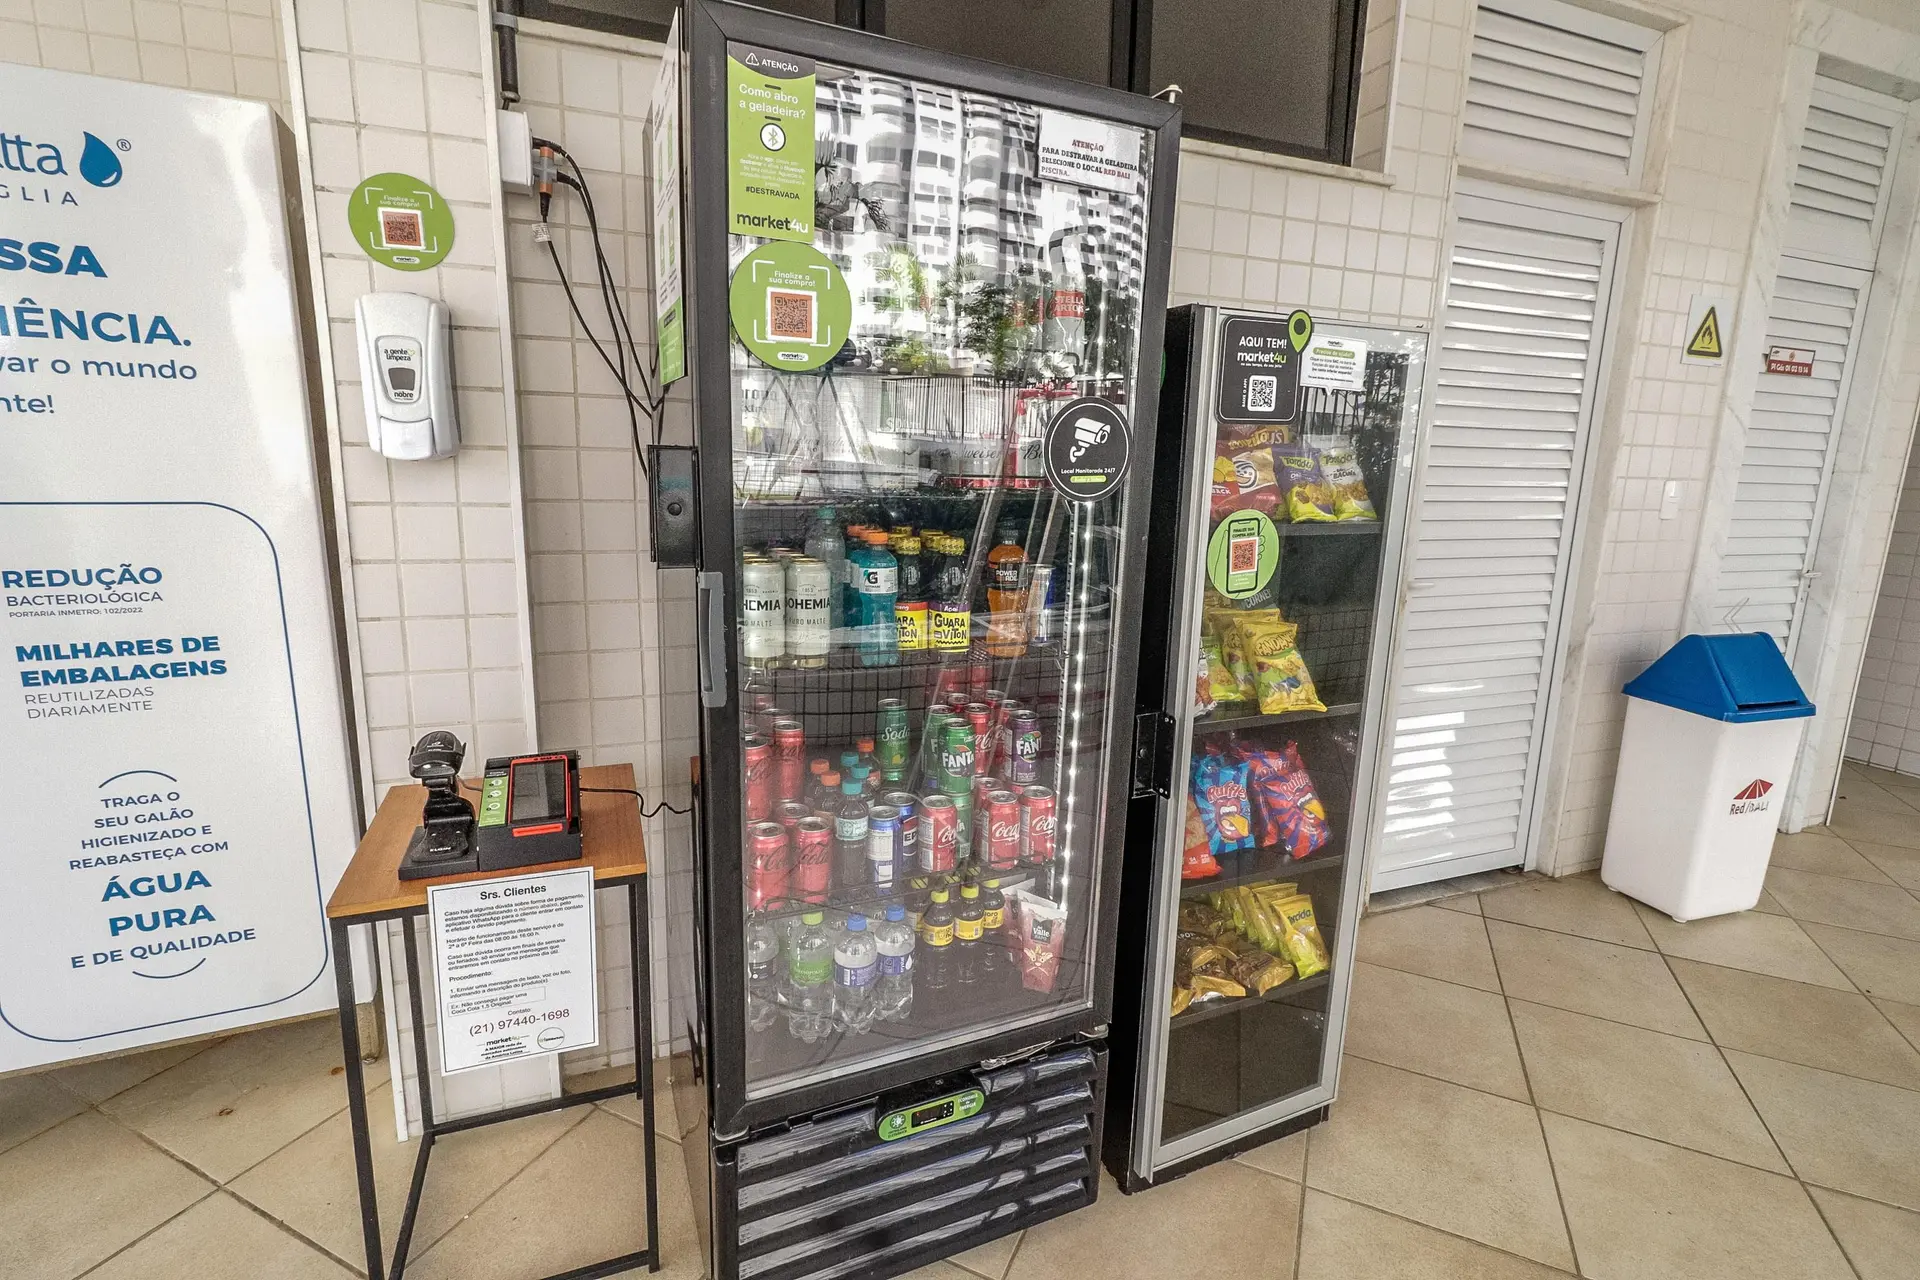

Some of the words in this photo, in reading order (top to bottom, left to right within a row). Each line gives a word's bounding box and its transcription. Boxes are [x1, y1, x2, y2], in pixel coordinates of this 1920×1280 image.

[761, 59, 799, 73] ATENÇÃO
[739, 84, 772, 99] Como
[774, 92, 799, 105] abro
[739, 100, 746, 108] a
[749, 100, 806, 120] geladeira?
[0, 132, 68, 176] tta
[1072, 139, 1104, 152] ATENÇÃO
[1042, 147, 1059, 156] PARA
[1061, 150, 1098, 163] DESTRAVAR
[1105, 159, 1138, 172] GELADEIRA
[1042, 157, 1075, 168] SELECIONE
[1082, 164, 1103, 174] LOCAL
[1103, 168, 1116, 177] RED
[746, 186, 800, 200] #DESTRAVADA
[736, 212, 809, 234] market4u
[774, 271, 803, 280] Finalize
[784, 278, 816, 287] compra!
[1239, 336, 1263, 348] AQUI
[1266, 337, 1288, 350] TEM!
[1237, 351, 1287, 363] market4u
[51, 358, 71, 375] o
[82, 359, 197, 380] mundo
[2, 563, 163, 590] REDUÇÃO
[6, 590, 163, 607] BACTERIOLÓGICA
[9, 610, 56, 618] PORTARIA
[58, 608, 102, 617] INMETRO:
[104, 607, 143, 615] 102/2022
[16, 638, 173, 662] MILHARES
[181, 636, 220, 653] DE
[20, 659, 227, 687] EMBALAGENS
[24, 686, 154, 704] REUTILIZADAS
[27, 700, 153, 719] DIARIAMENTE
[100, 793, 163, 809] TRAGA
[167, 791, 180, 802] O
[94, 815, 129, 829] SEU
[134, 807, 194, 825] GALÃO
[81, 826, 197, 850] HIGIENIZADO
[201, 825, 212, 835] E
[68, 846, 187, 870] REABASTEÇA
[190, 841, 229, 855] COM
[101, 869, 212, 902] ÁGUA
[480, 889, 500, 900] Srs.
[503, 883, 546, 897] Clientes
[473, 905, 494, 913] alguma
[554, 893, 584, 902] pagamento,
[109, 904, 216, 937] PURA
[472, 915, 500, 924] WhatsApp
[71, 955, 86, 969] E
[92, 949, 124, 966] DE
[130, 928, 257, 960] QUALIDADE
[449, 970, 492, 982] Procedimento:
[469, 1022, 494, 1036] (21)
[498, 1008, 569, 1030] 97440-1698
